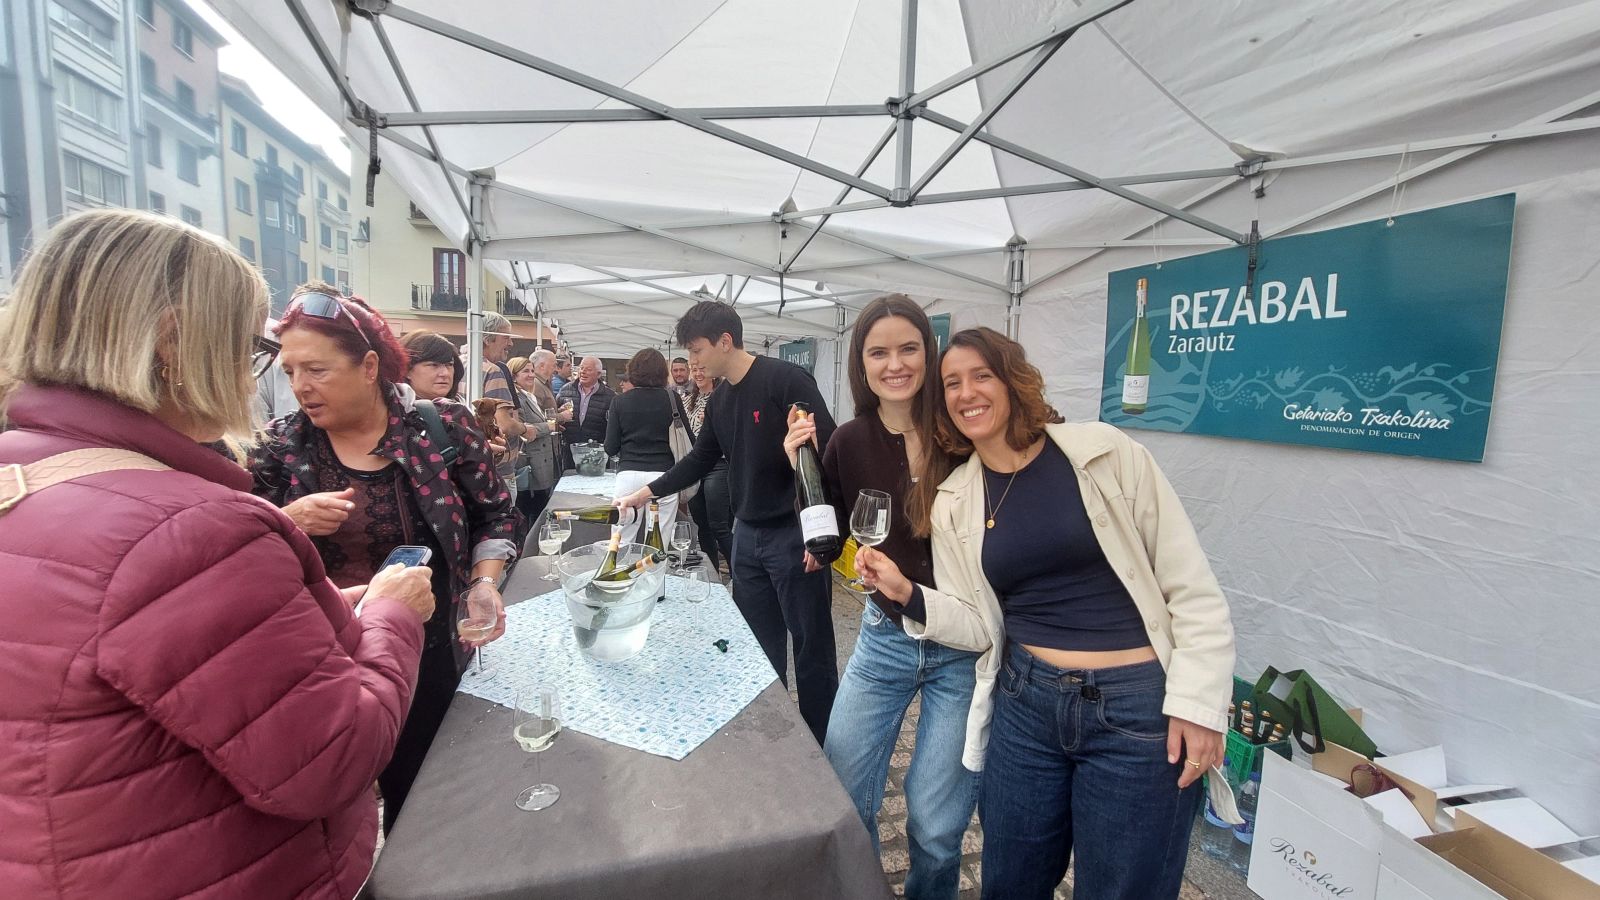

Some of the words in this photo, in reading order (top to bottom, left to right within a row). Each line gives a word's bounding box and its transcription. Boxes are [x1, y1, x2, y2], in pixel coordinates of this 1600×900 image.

[1169, 273, 1347, 331] REZABAL
[1168, 332, 1236, 354] Zarautz
[1283, 404, 1352, 422] Getariako
[1360, 408, 1450, 430] Txakolina
[1300, 424, 1365, 436] DENOMINACION
[1368, 429, 1380, 437] DE
[1383, 430, 1421, 440] ORIGEN
[1270, 837, 1354, 898] Rezabal
